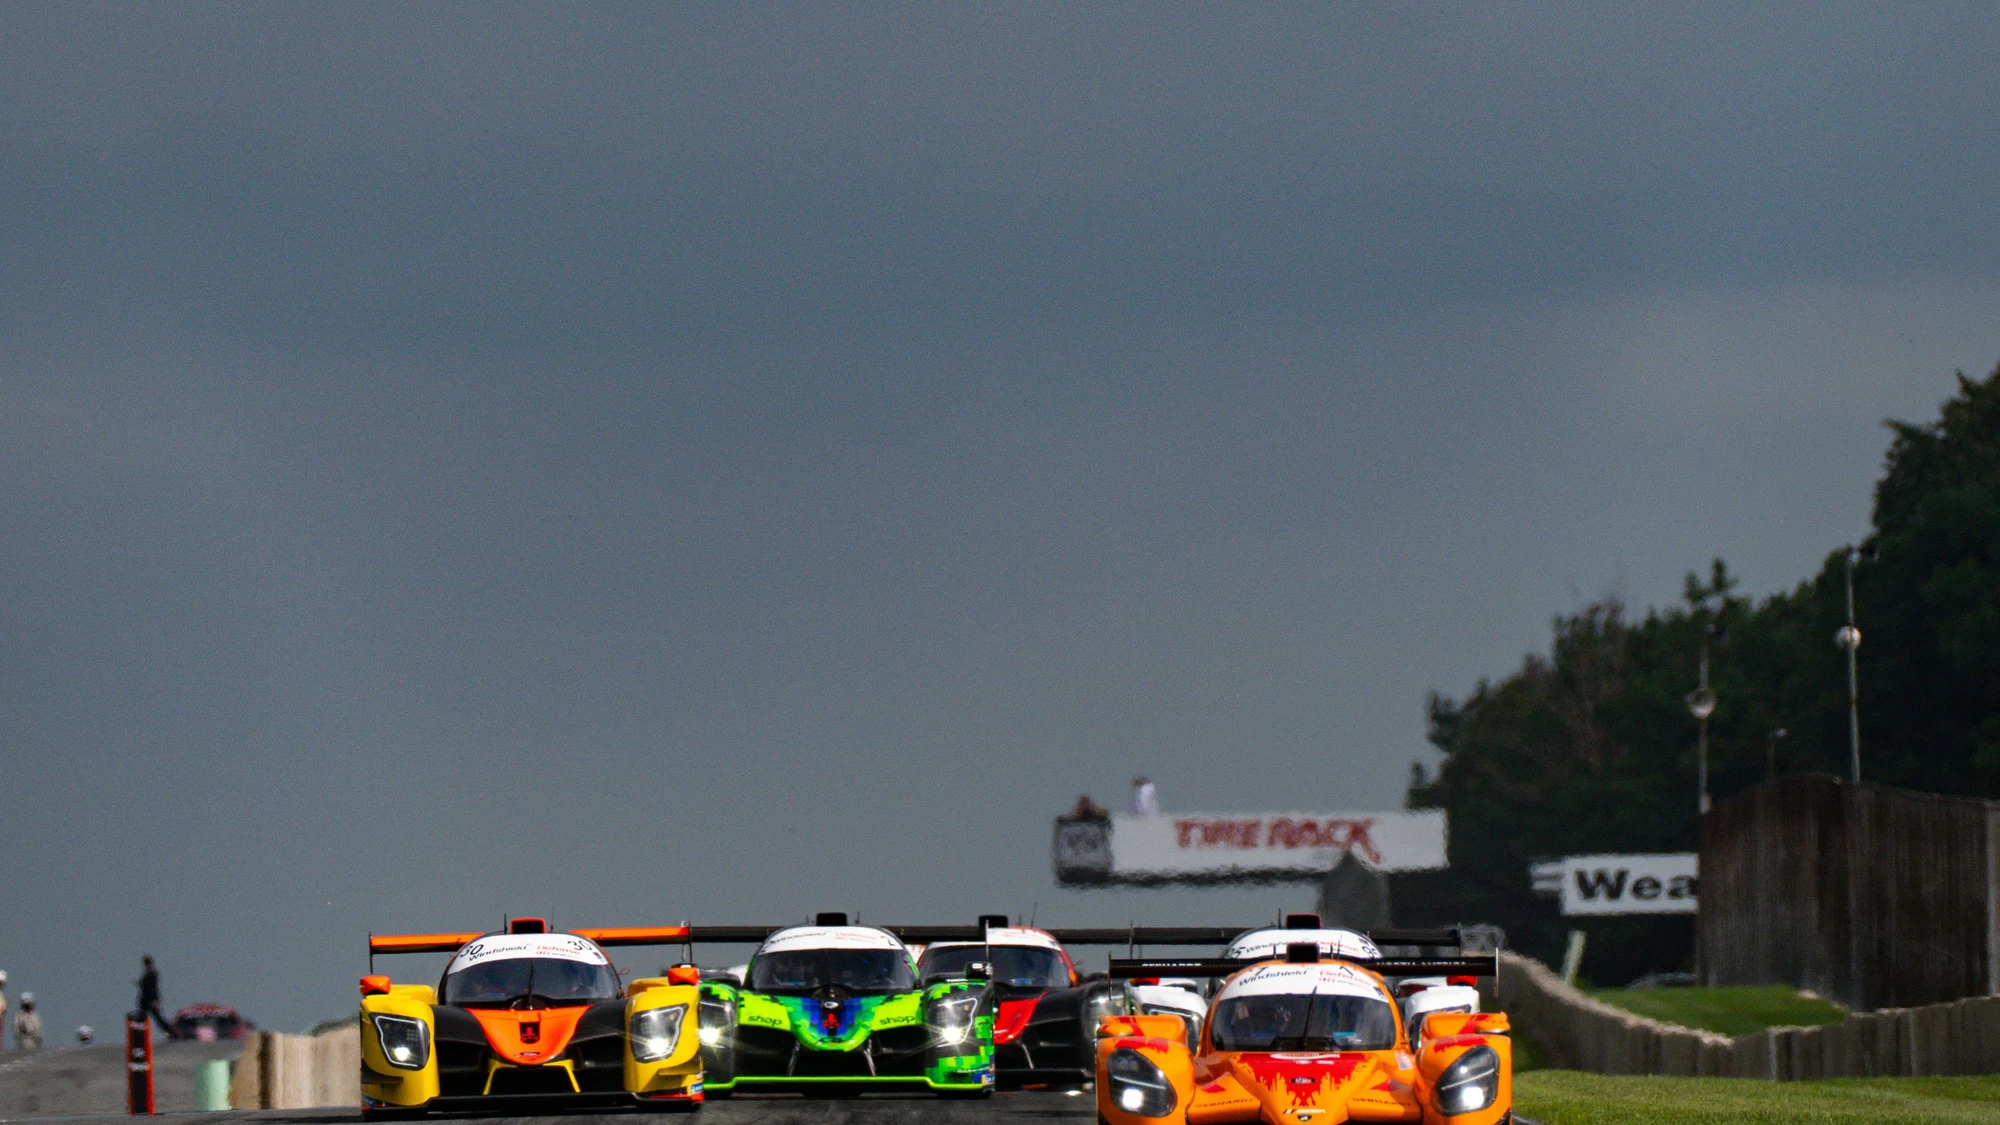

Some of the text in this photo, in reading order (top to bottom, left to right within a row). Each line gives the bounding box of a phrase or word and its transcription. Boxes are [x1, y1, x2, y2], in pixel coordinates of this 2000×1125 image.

[460, 944, 484, 957] 30
[567, 940, 593, 951] 30
[469, 945, 527, 961] Windshield
[536, 945, 581, 955] Defense
[1239, 970, 1308, 986] Windshield
[1319, 970, 1372, 986] Defense
[748, 1014, 782, 1026] shop
[879, 1015, 915, 1026] shop
